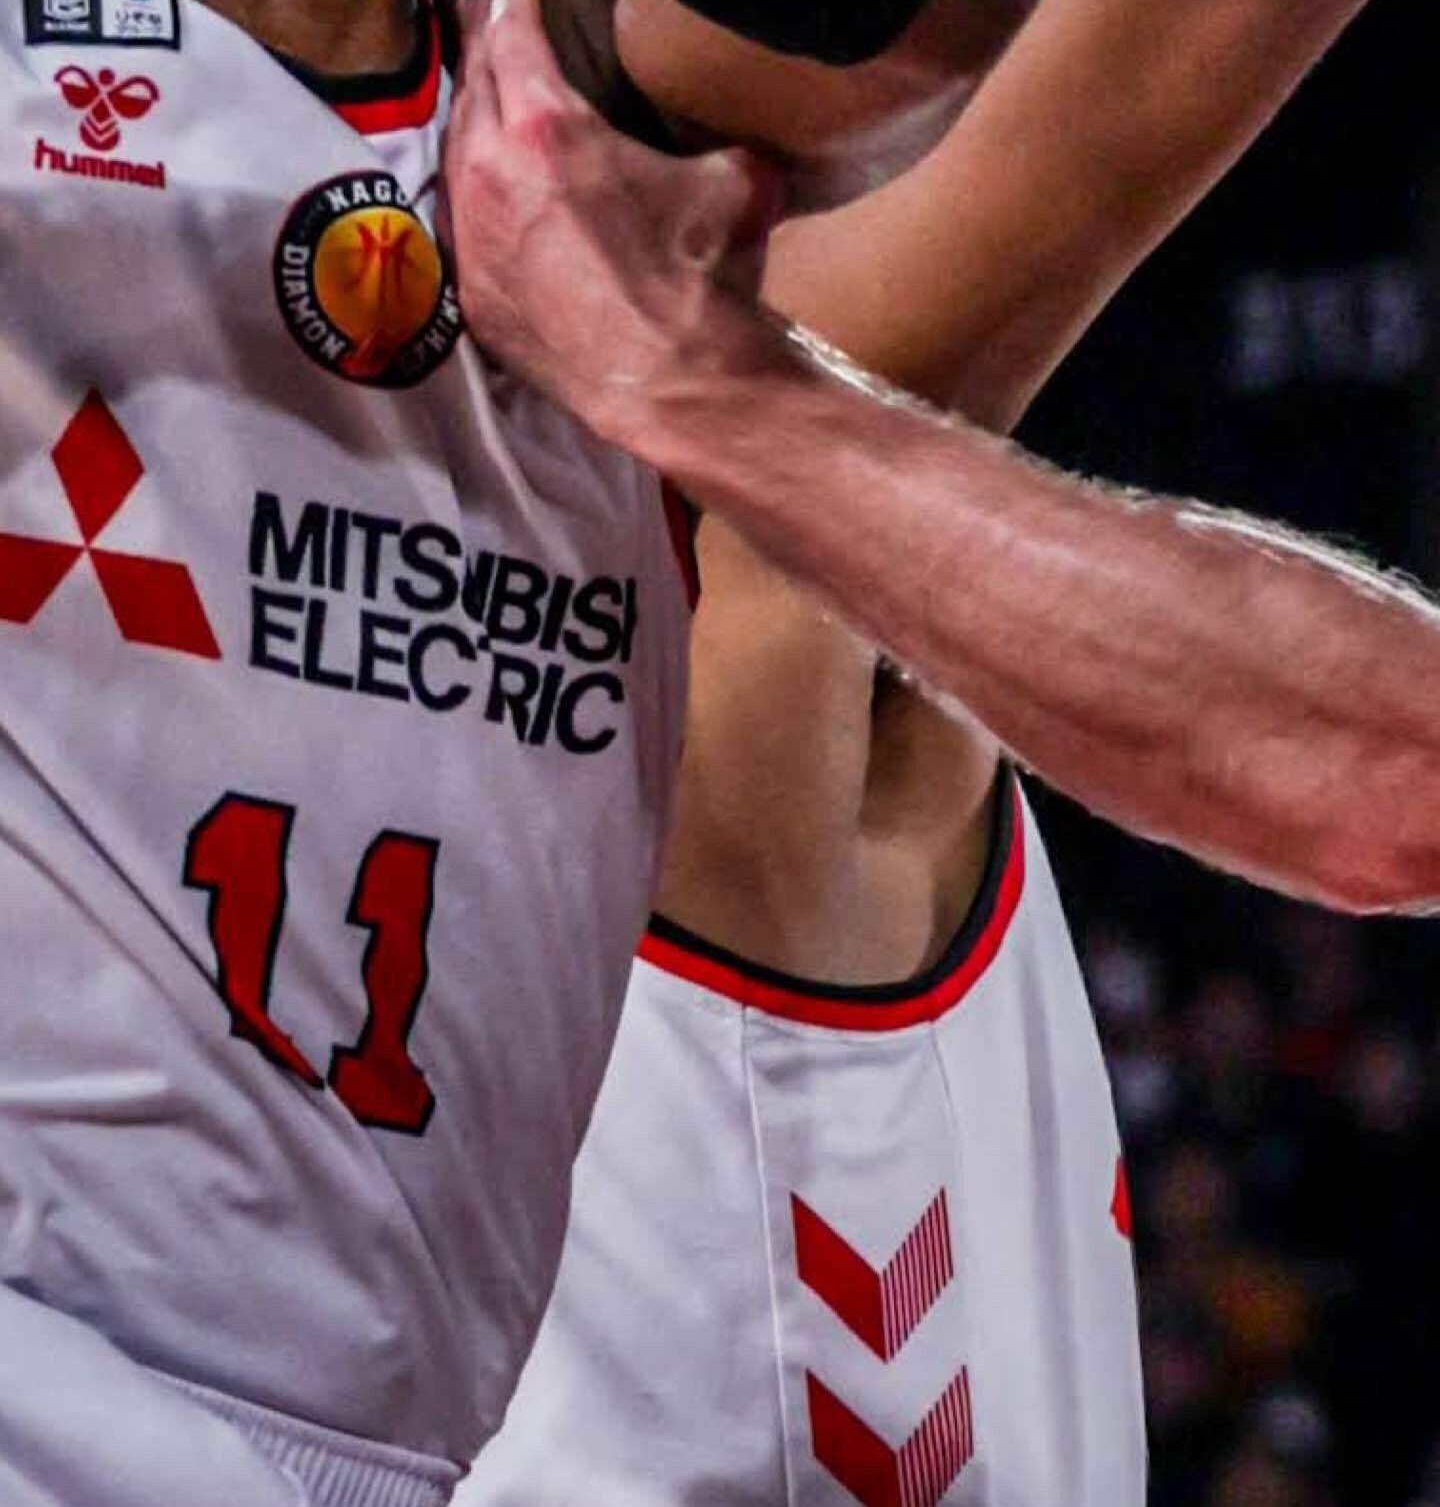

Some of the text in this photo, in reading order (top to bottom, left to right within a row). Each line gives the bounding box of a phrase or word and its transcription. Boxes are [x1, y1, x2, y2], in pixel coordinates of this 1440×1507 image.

[35, 137, 165, 190] hummel
[248, 585, 625, 755] ELECRIC
[182, 791, 441, 1137] 11
